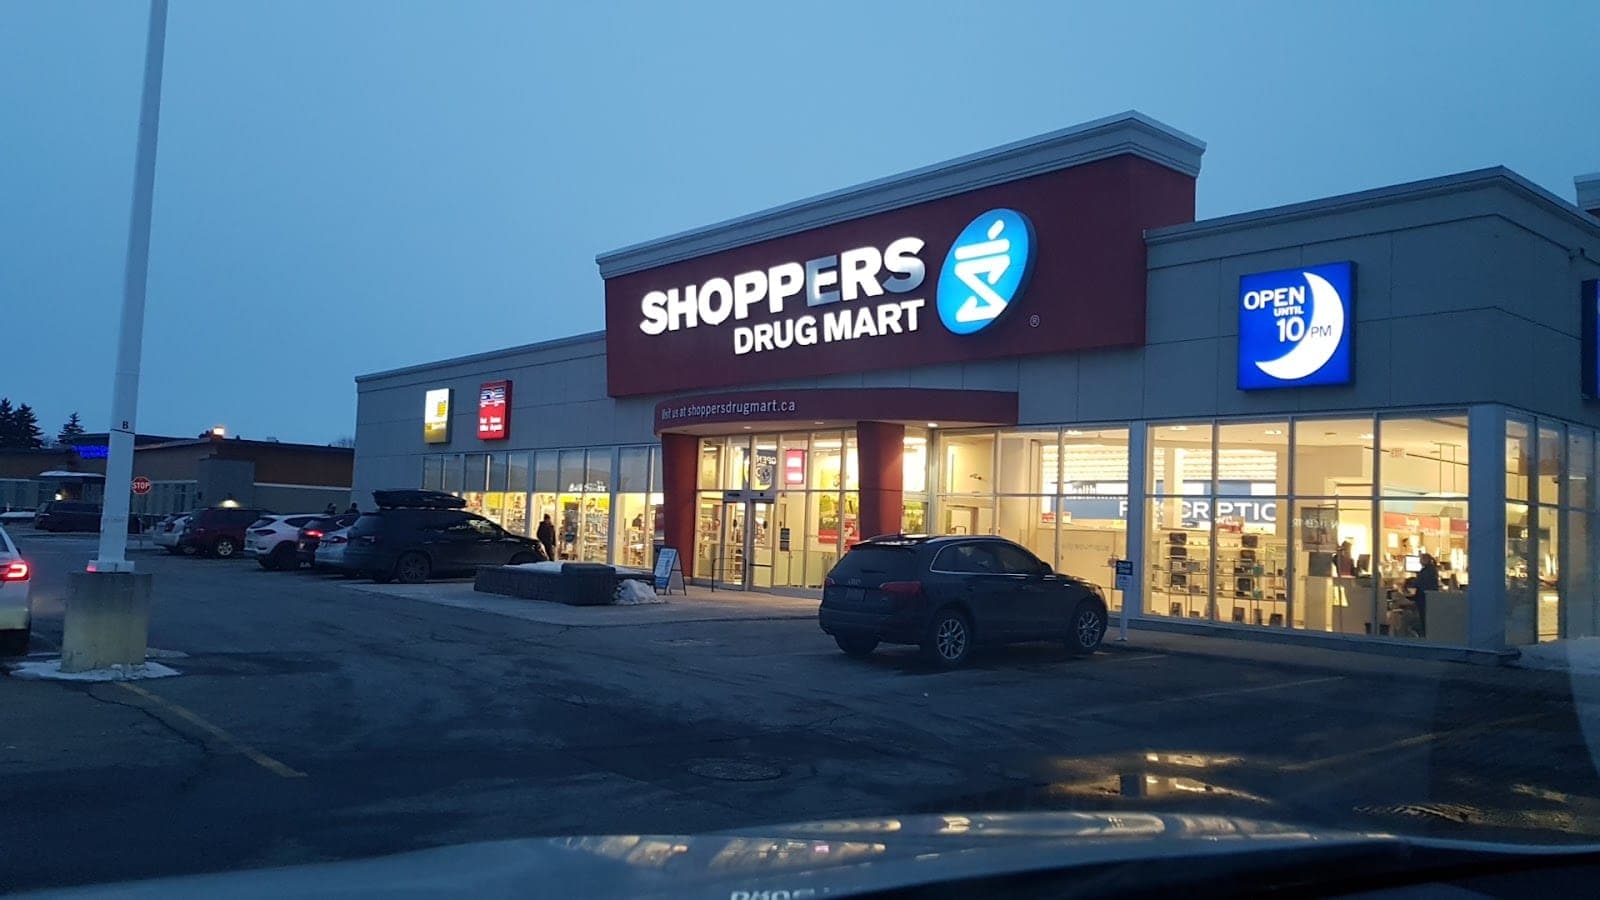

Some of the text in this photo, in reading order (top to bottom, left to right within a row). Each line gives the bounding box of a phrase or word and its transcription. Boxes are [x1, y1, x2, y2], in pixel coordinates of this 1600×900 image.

[639, 236, 927, 336] SHOPPERS
[1243, 286, 1306, 311] OPEN
[1273, 306, 1304, 317] UNTIL
[733, 299, 926, 356] DRUG MART
[1276, 316, 1332, 343] 10 PM
[687, 400, 796, 417] shoppersdrugmart.ca
[122, 420, 129, 429] B
[133, 482, 149, 490] STOP
